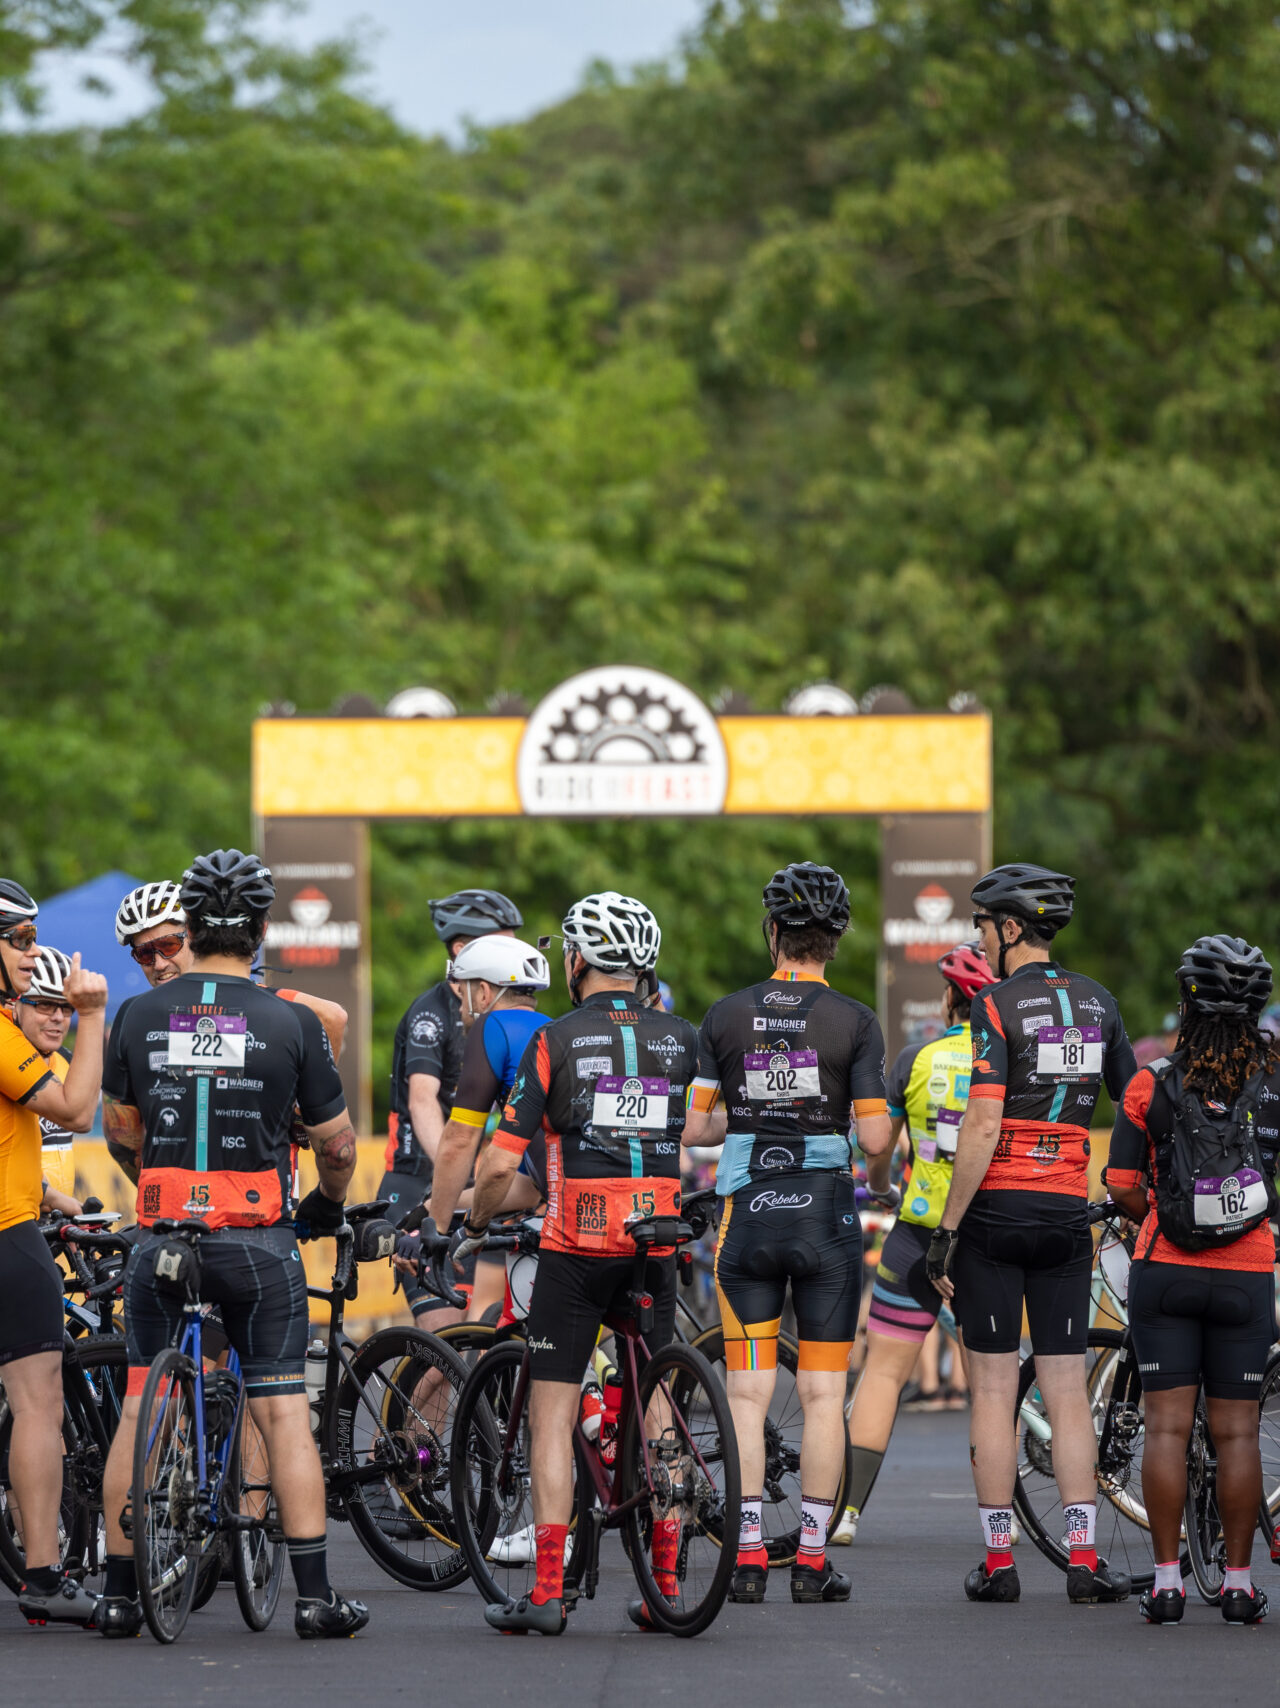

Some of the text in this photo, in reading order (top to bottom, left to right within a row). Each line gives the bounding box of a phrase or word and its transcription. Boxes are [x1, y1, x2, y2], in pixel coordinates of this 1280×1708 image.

[768, 1018, 806, 1029] WAGNER
[191, 1034, 223, 1057] 222
[647, 1043, 686, 1053] MARANTO
[1060, 1044, 1084, 1066] 181
[229, 1078, 264, 1089] WAGNER
[765, 1069, 798, 1091] 202
[149, 1087, 186, 1096] CONOWINGO
[616, 1095, 648, 1118] 220
[215, 1109, 261, 1119] WHITEFORD
[222, 1136, 245, 1148] KSC
[549, 1143, 558, 1164] RIDE
[655, 1143, 676, 1155] KSC
[143, 1185, 161, 1194] JOE'S
[190, 1184, 210, 1206] 15
[144, 1194, 160, 1204] BIKE
[549, 1192, 558, 1219] FEAST
[576, 1192, 606, 1207] JOE'S
[631, 1189, 656, 1218] 15
[749, 1191, 813, 1212] Rebels
[1217, 1190, 1248, 1216] 162
[143, 1204, 161, 1214] SHOP
[576, 1204, 607, 1218] BIKE
[576, 1216, 607, 1229] SHOP
[1225, 1213, 1244, 1222] PATRICE
[991, 1533, 1011, 1546] FEAS
